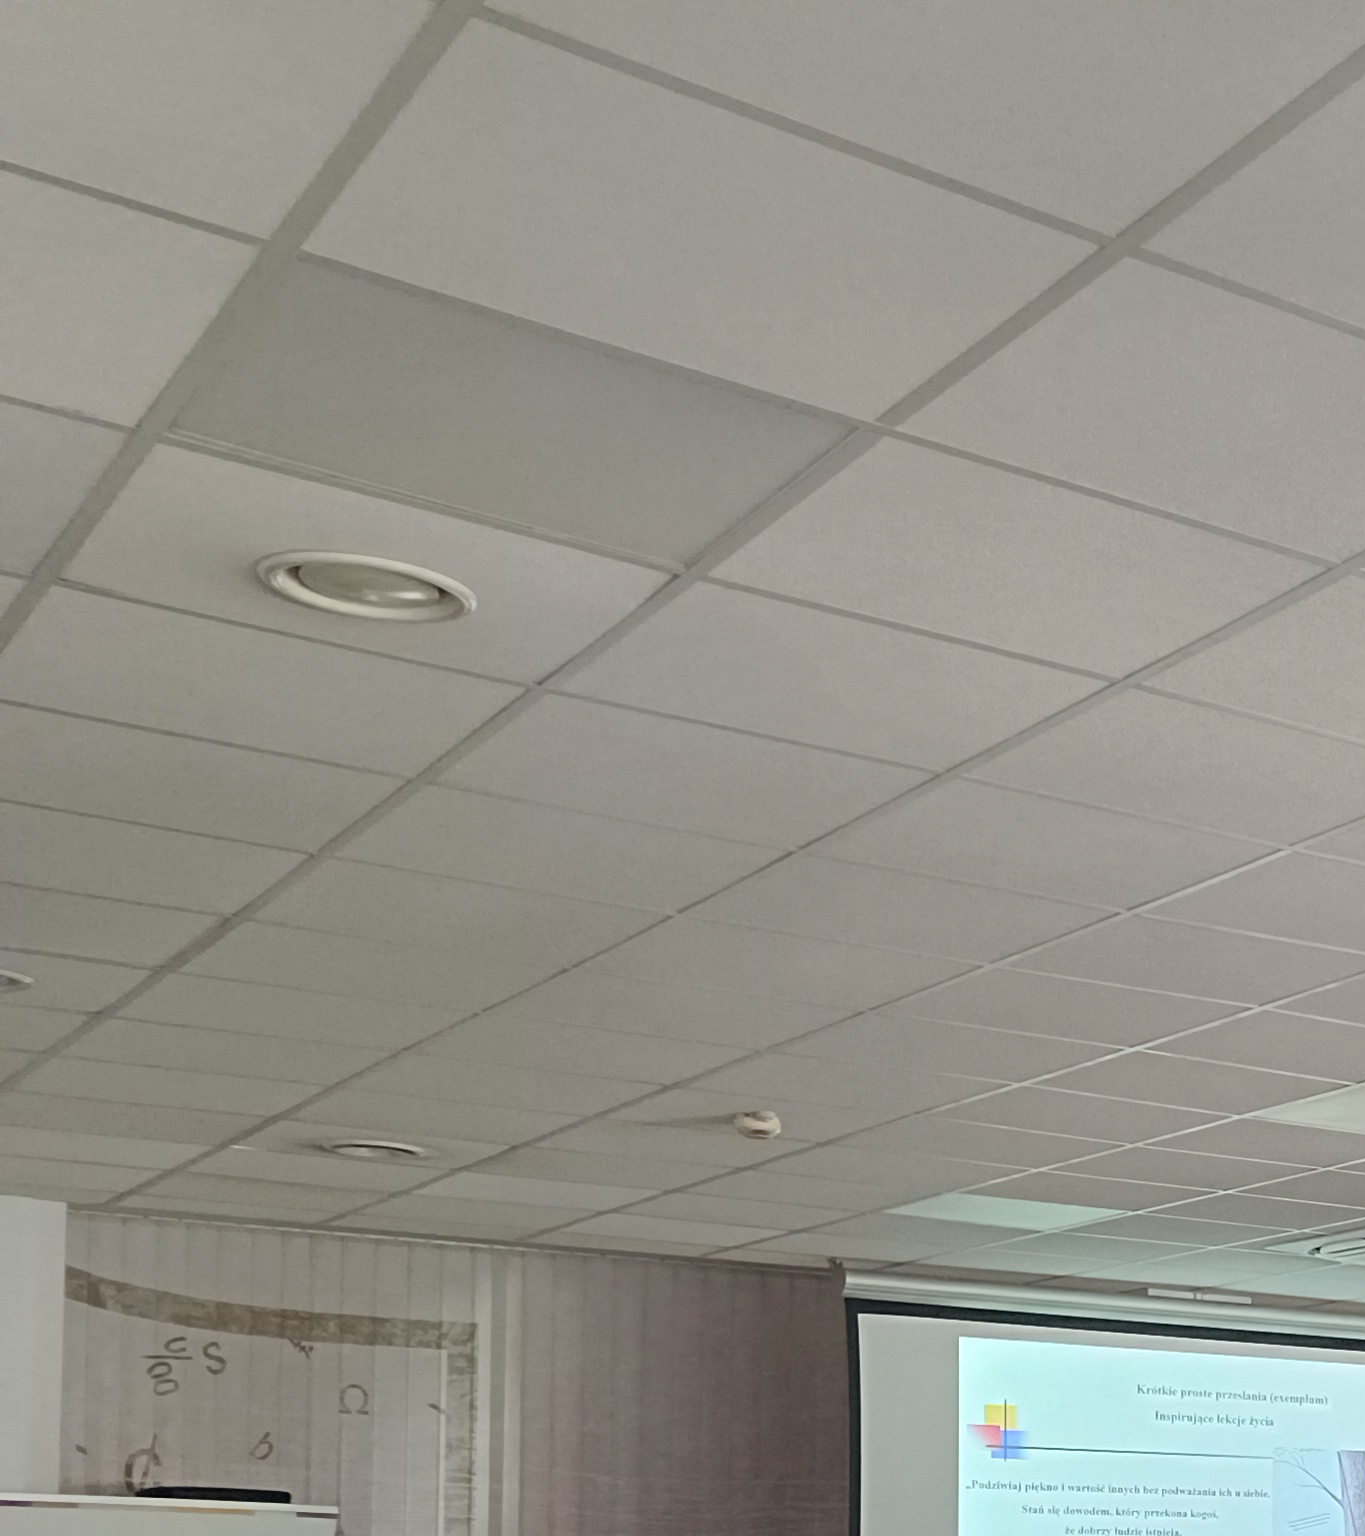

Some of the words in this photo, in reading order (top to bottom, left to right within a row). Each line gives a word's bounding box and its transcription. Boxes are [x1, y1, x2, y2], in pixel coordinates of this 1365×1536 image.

[1137, 1384, 1177, 1397] Krótkie
[1181, 1388, 1213, 1399] proste
[1155, 1411, 1214, 1425] Inspirujące
[1249, 1416, 1274, 1427] życia
[1025, 1482, 1058, 1493] piękno
[1108, 1484, 1140, 1496] innych
[1143, 1485, 1159, 1495] bez
[1219, 1488, 1232, 1497] ich
[1047, 1505, 1060, 1517] się
[1116, 1507, 1140, 1518] który
[1144, 1508, 1187, 1519] przekona
[1115, 1526, 1143, 1536] ludzie
